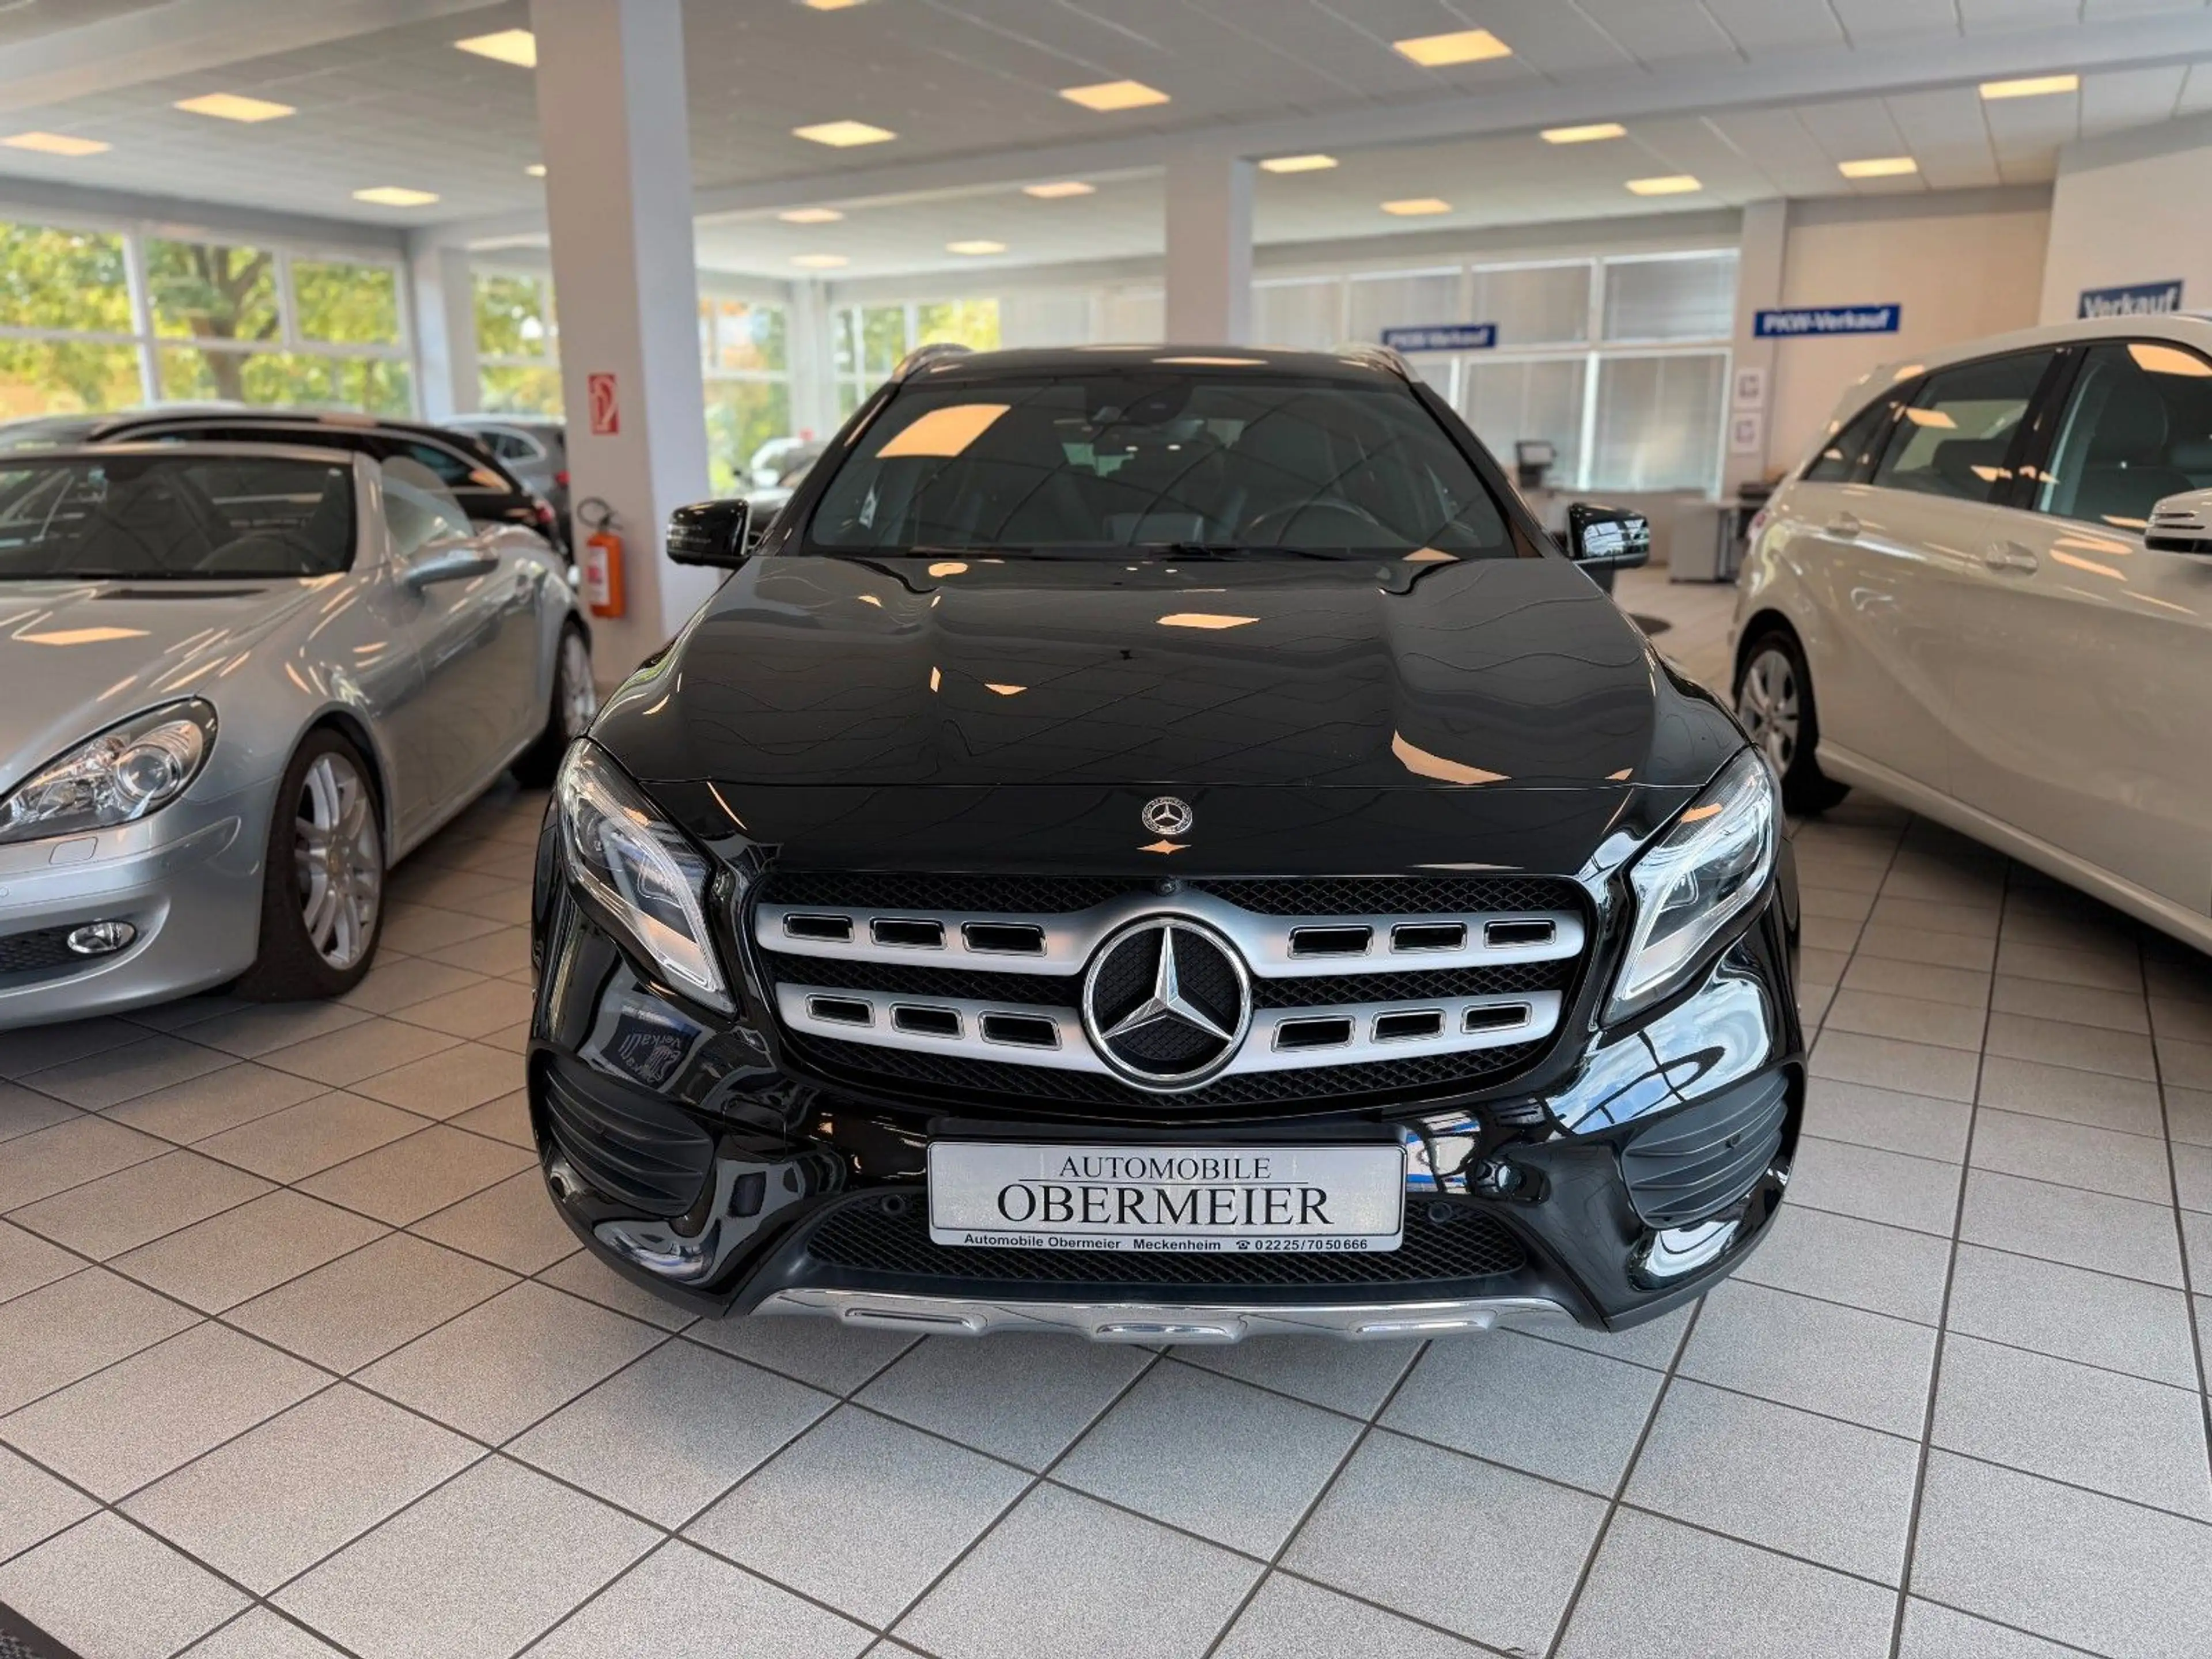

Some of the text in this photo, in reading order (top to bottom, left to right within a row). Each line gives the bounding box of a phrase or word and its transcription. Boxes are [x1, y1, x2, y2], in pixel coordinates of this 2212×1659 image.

[1059, 1156, 1272, 1180] AUTOMOBILE
[997, 1184, 1335, 1225] OBERMEIER
[964, 1234, 1044, 1248] Automobile
[1048, 1237, 1122, 1250] Obermeier
[1133, 1238, 1222, 1251] Meckenheim
